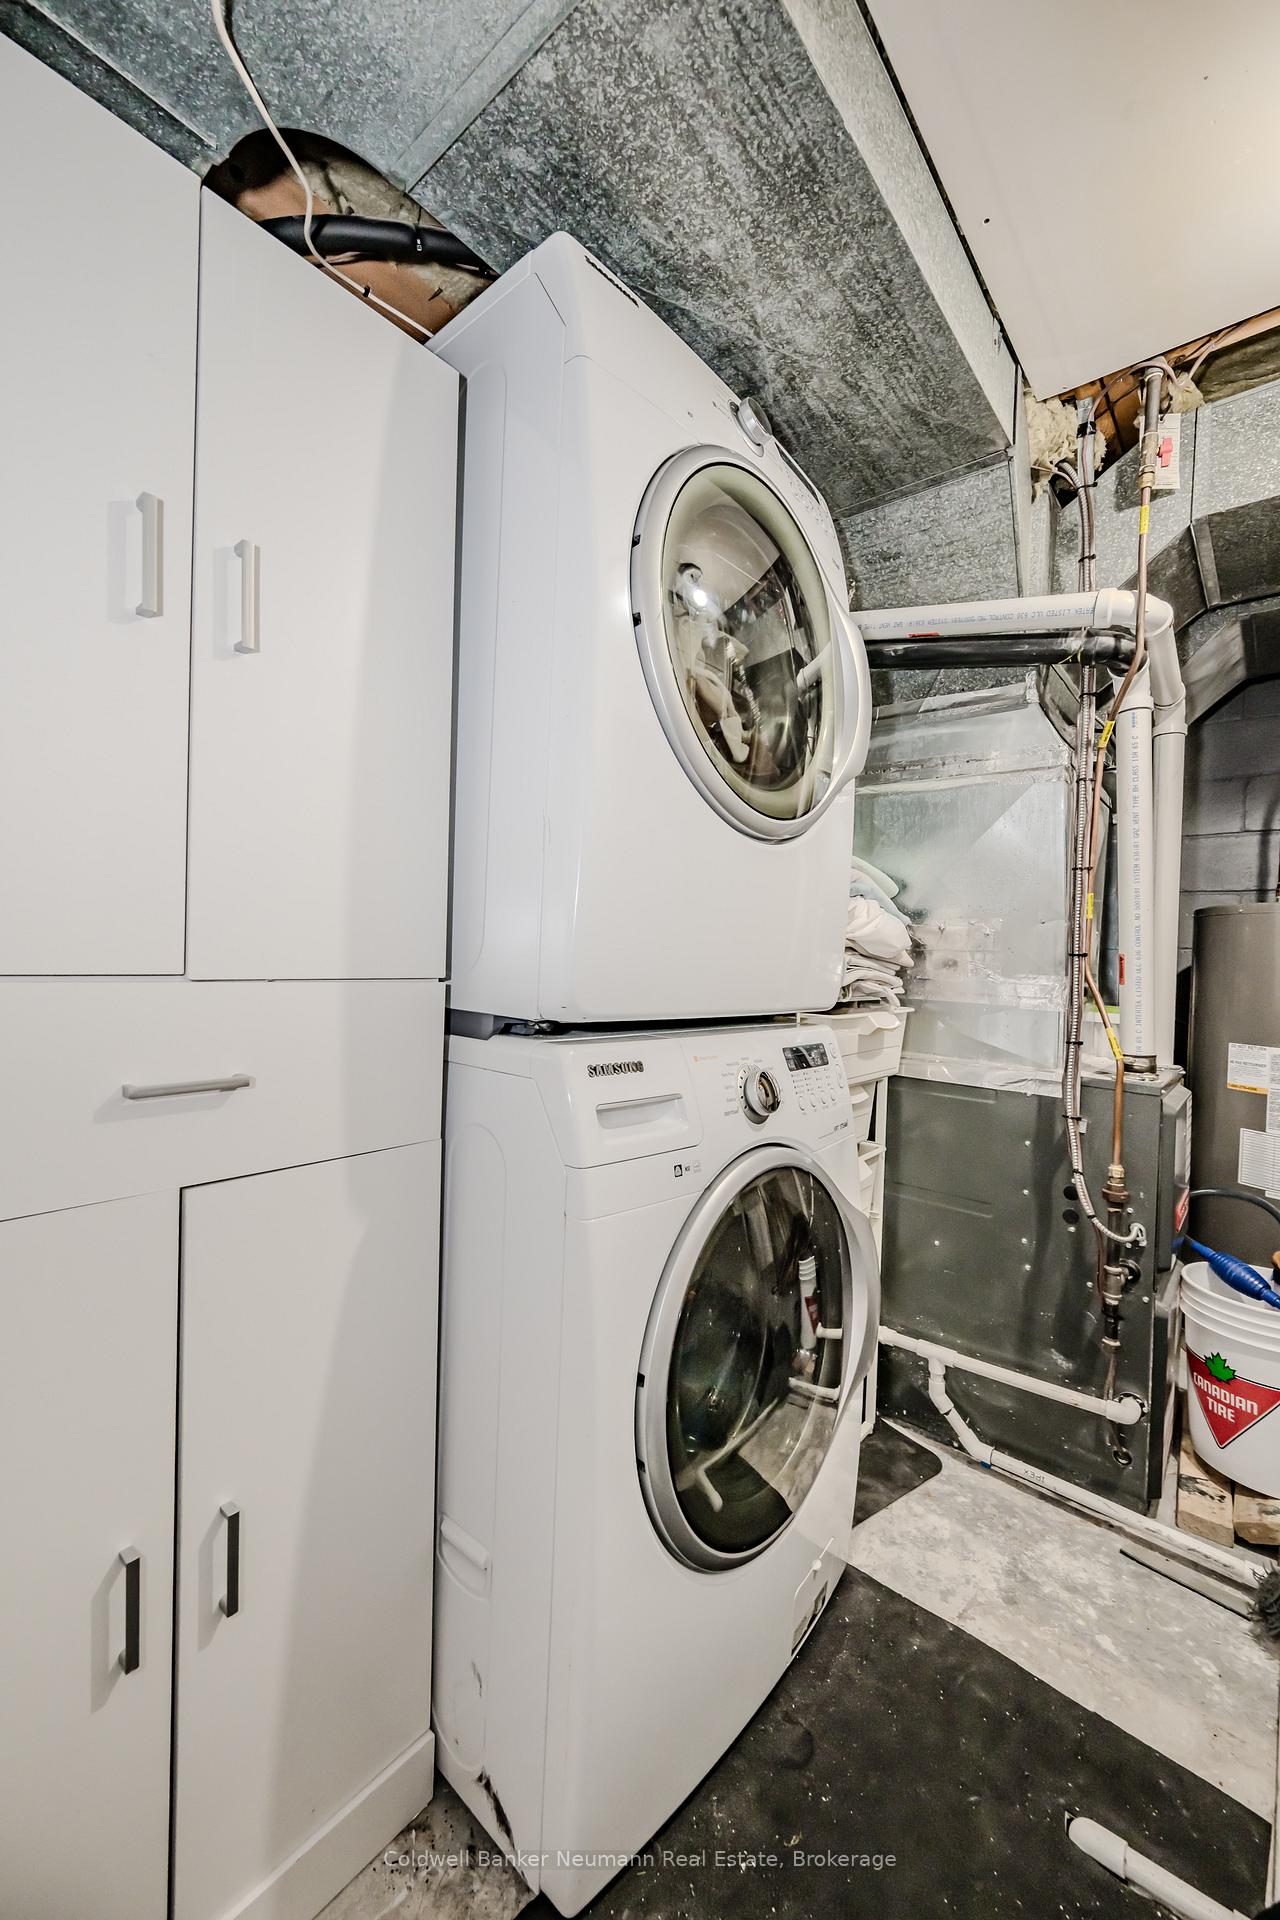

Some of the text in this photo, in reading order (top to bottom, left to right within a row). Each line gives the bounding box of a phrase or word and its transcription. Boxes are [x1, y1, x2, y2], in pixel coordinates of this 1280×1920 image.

[587, 1060, 645, 1078] SAMSUNG
[1193, 1371, 1258, 1416] CANADIAN
[1206, 1396, 1236, 1423] TIRE
